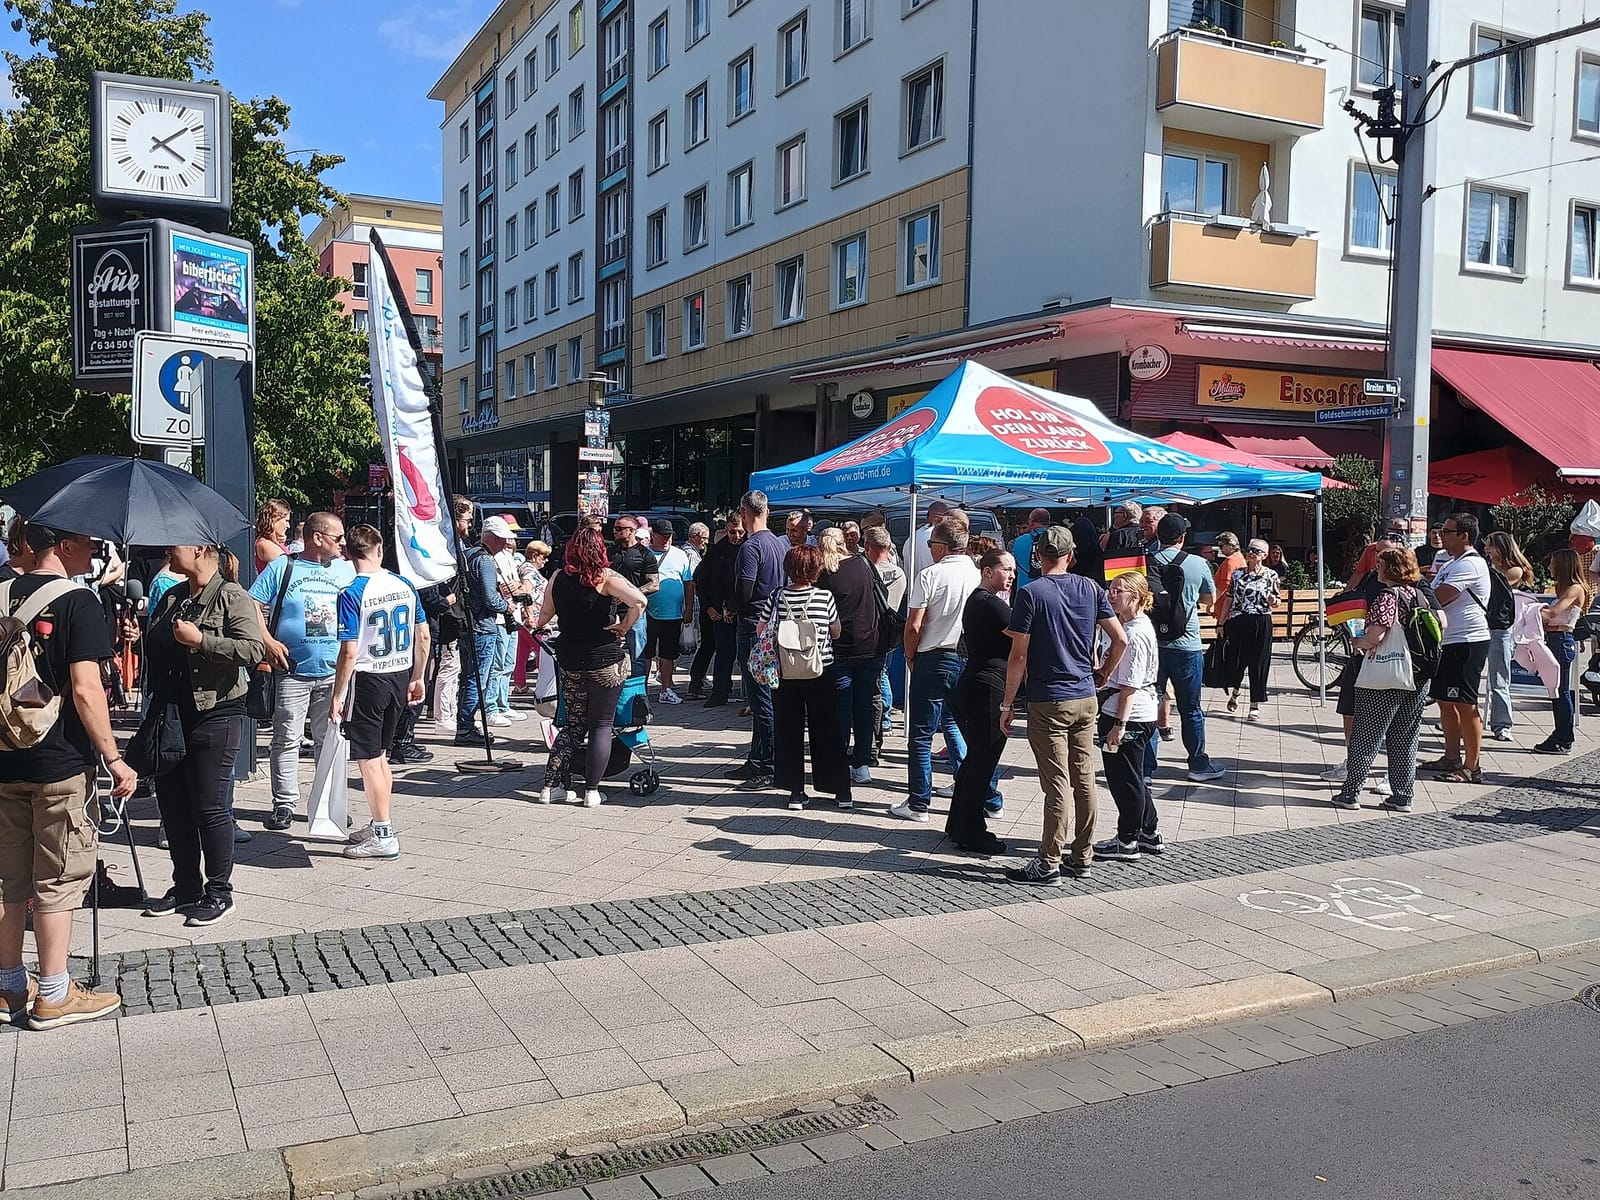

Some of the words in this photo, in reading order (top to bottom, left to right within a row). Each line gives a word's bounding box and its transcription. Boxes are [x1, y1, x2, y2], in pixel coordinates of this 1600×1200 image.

[182, 260, 238, 286] biberticket
[88, 298, 140, 308] Bestattungen
[93, 328, 106, 339] Tag
[114, 327, 136, 337] Nacht
[1131, 358, 1162, 371] Krombacher
[1211, 381, 1242, 396] Milano
[1366, 382, 1384, 393] Breiter
[989, 408, 1032, 421] HOL
[1029, 410, 1064, 424] DIR
[1319, 406, 1389, 420] Goldschmiedebrücke
[991, 422, 1040, 435] DEIN
[1037, 424, 1087, 438] LAND
[1018, 436, 1096, 450] ZURÜCK
[1126, 447, 1201, 467] AfD
[834, 465, 891, 483] www.afd-md.de
[955, 465, 1049, 480] www.afd-md.de
[765, 476, 811, 492] www.afd-md.de
[367, 603, 412, 660] 38
